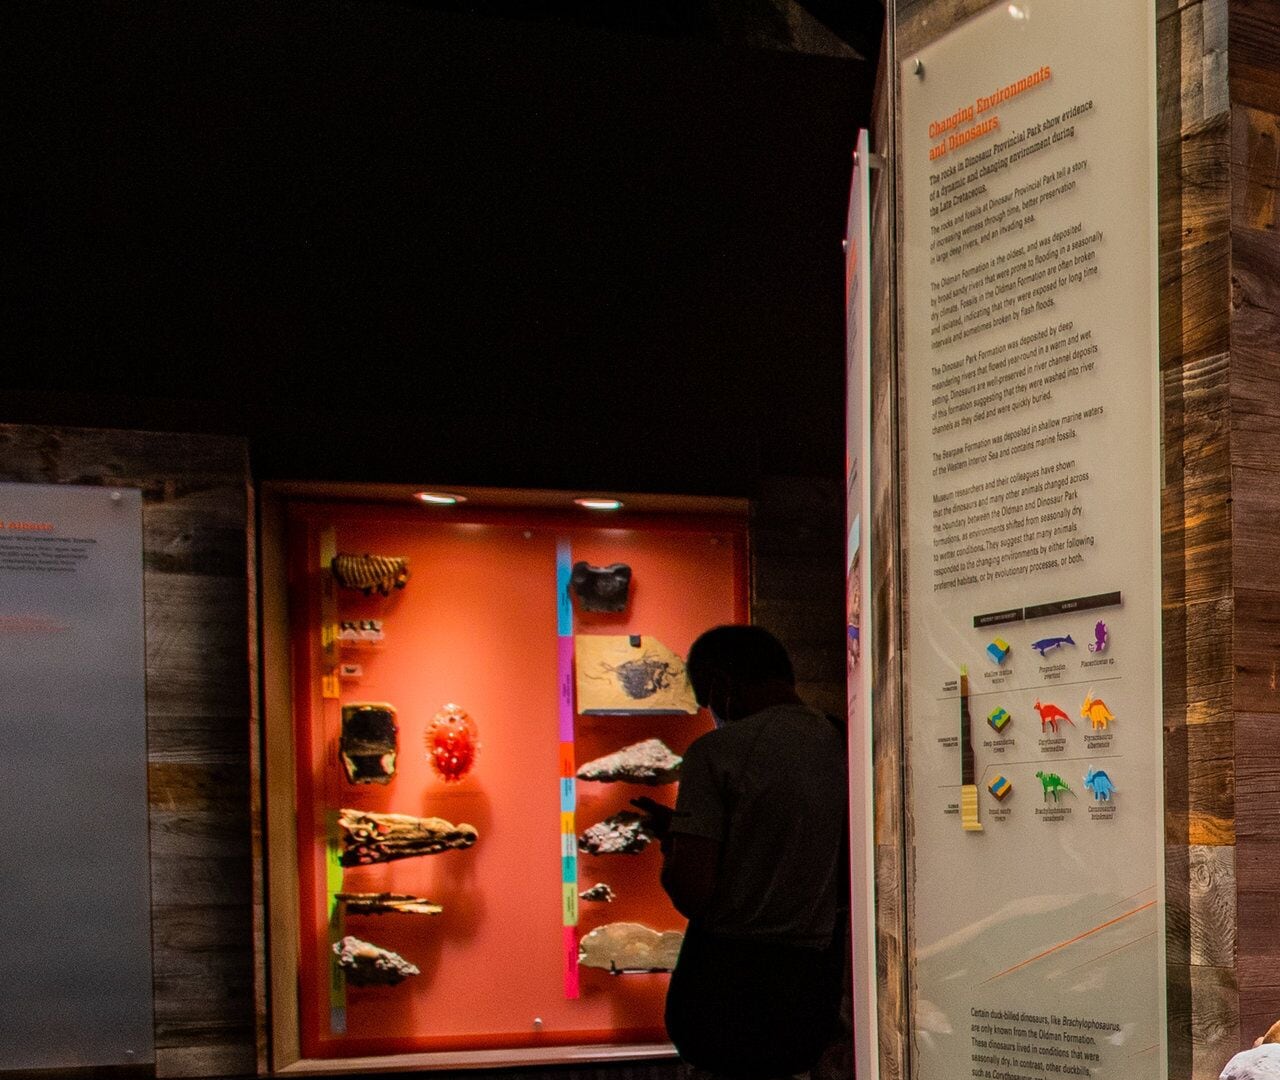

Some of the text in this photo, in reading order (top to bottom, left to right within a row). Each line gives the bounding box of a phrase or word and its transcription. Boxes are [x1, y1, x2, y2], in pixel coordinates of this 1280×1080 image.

[929, 67, 1050, 138] Changing Environments
[929, 116, 999, 160] and Dinosaurs
[965, 149, 992, 168] Dinosaur
[993, 131, 1026, 155] Provincial
[1027, 123, 1041, 138] Park
[1043, 117, 1060, 131] show
[1062, 101, 1093, 121] evidence
[967, 169, 978, 183] and
[980, 158, 1008, 177] changing
[1010, 135, 1051, 163] environment
[1052, 126, 1074, 143] during
[971, 1008, 989, 1017] Certain
[991, 1010, 1019, 1020] duck-billed
[1051, 1016, 1061, 1024] like
[981, 1025, 993, 1035] only
[994, 1025, 1012, 1035] known
[1014, 1027, 1027, 1036] from
[1028, 1029, 1038, 1037] the
[1039, 1030, 1062, 1040] Oldman
[972, 1037, 987, 1047] These
[989, 1040, 1015, 1050] dinosaurs
[1017, 1043, 1030, 1052] lived
[1039, 1047, 1070, 1057] conditions
[1071, 1050, 1083, 1059] that
[972, 1055, 1000, 1066] seasonally
[1046, 1062, 1061, 1071] other
[972, 1069, 984, 1077] such
